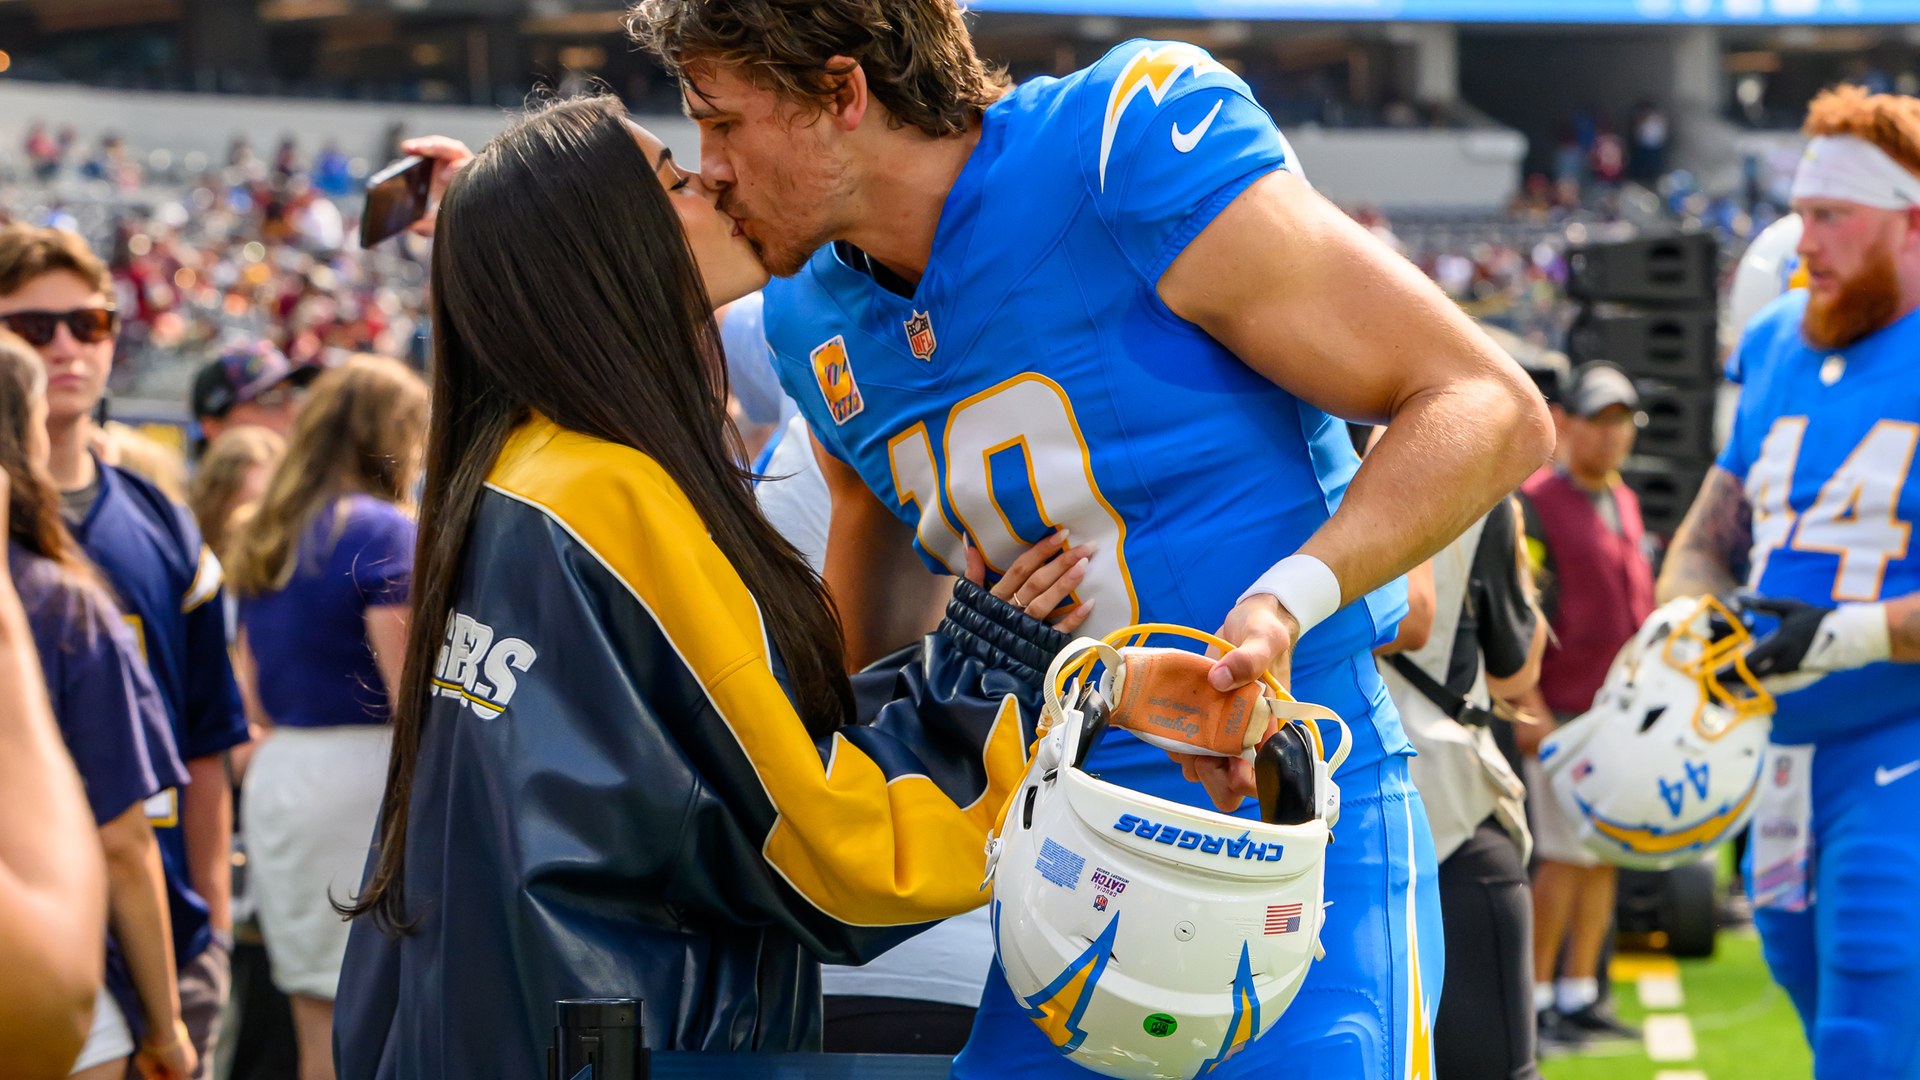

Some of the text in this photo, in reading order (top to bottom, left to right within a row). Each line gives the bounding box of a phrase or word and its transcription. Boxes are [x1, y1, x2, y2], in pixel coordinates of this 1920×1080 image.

[888, 372, 1139, 646] 10
[1744, 415, 1920, 602] 44
[1657, 756, 1710, 819] 44
[1113, 813, 1284, 862] CHARGERS
[1091, 871, 1126, 893] CATCH
[1094, 884, 1117, 898] CRUCIAL
